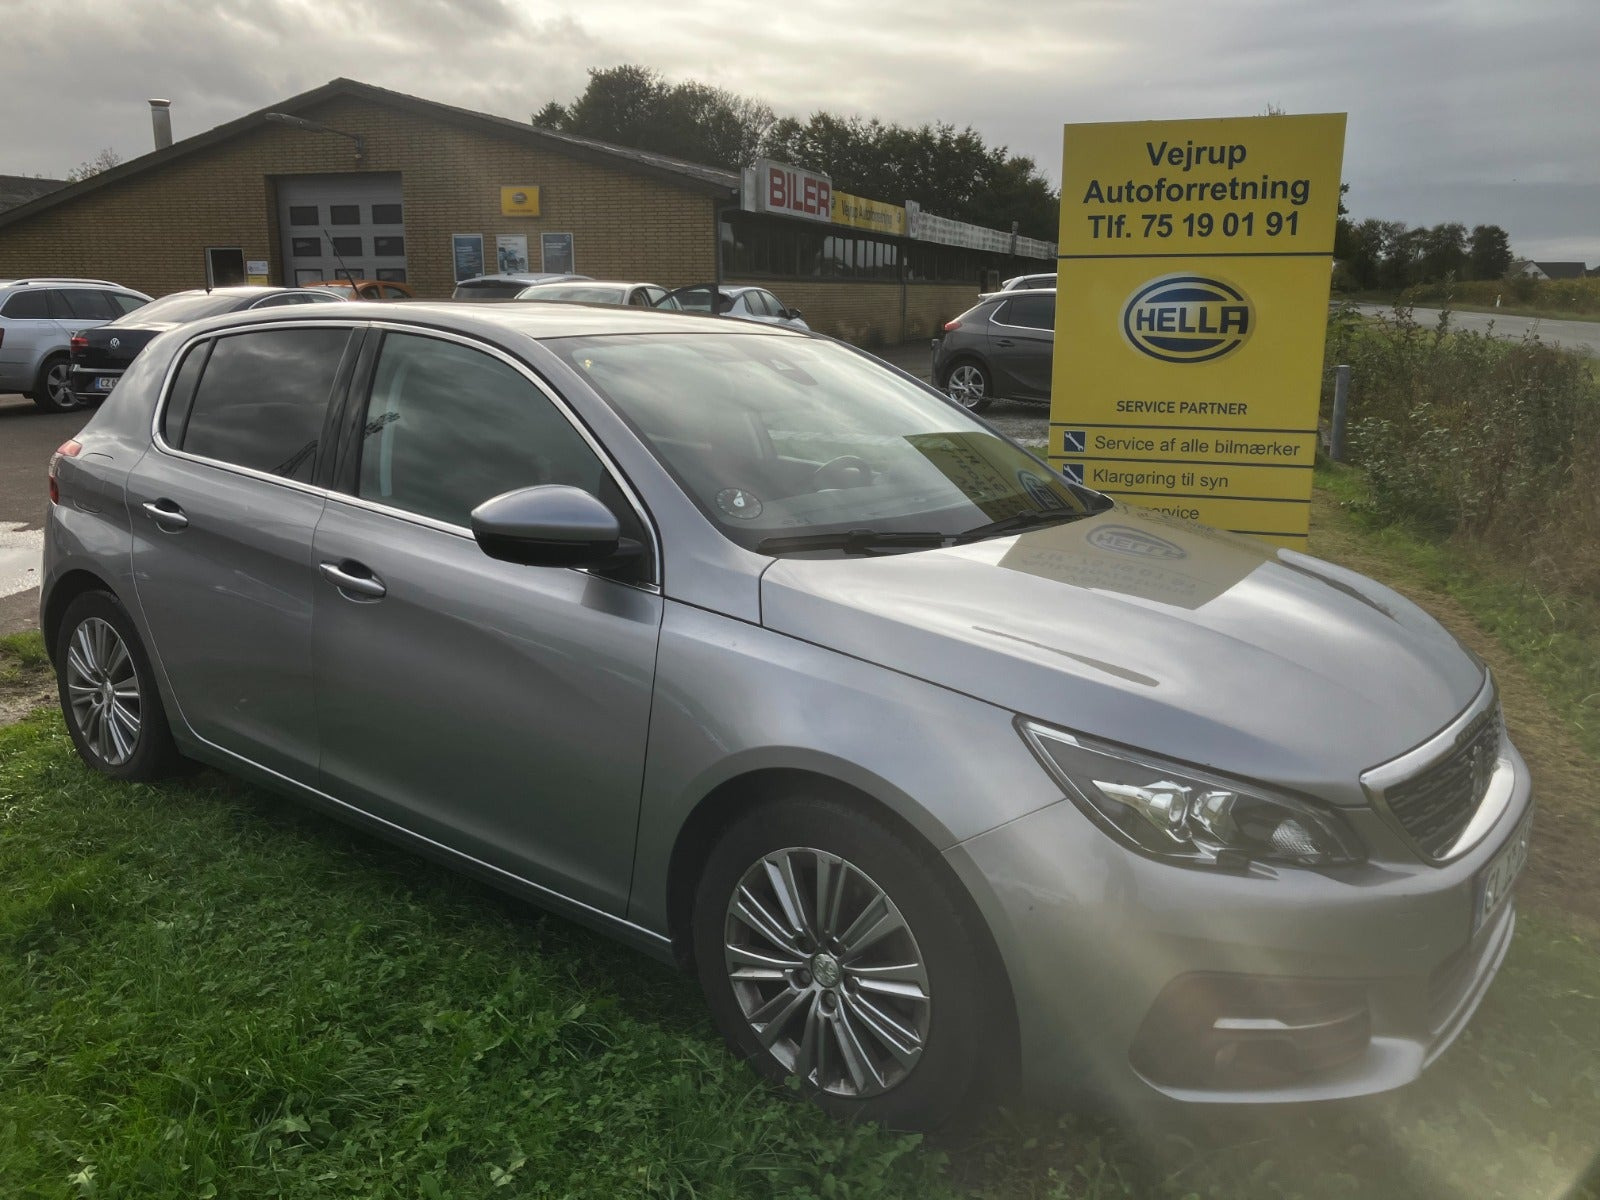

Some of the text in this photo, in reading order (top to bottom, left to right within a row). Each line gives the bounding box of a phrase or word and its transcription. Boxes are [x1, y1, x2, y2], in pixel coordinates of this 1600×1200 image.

[1147, 141, 1247, 172] Vejrup
[769, 167, 830, 218] BILER
[1083, 175, 1311, 206] Autoforretning
[1088, 211, 1298, 239] Tlf. 75 19 01 91
[1136, 306, 1249, 334] HELLA
[1116, 400, 1248, 416] SERVICE PARTNER
[1094, 435, 1301, 457] Service af alle bilmærker
[1093, 468, 1229, 491] Klargøring til syn
